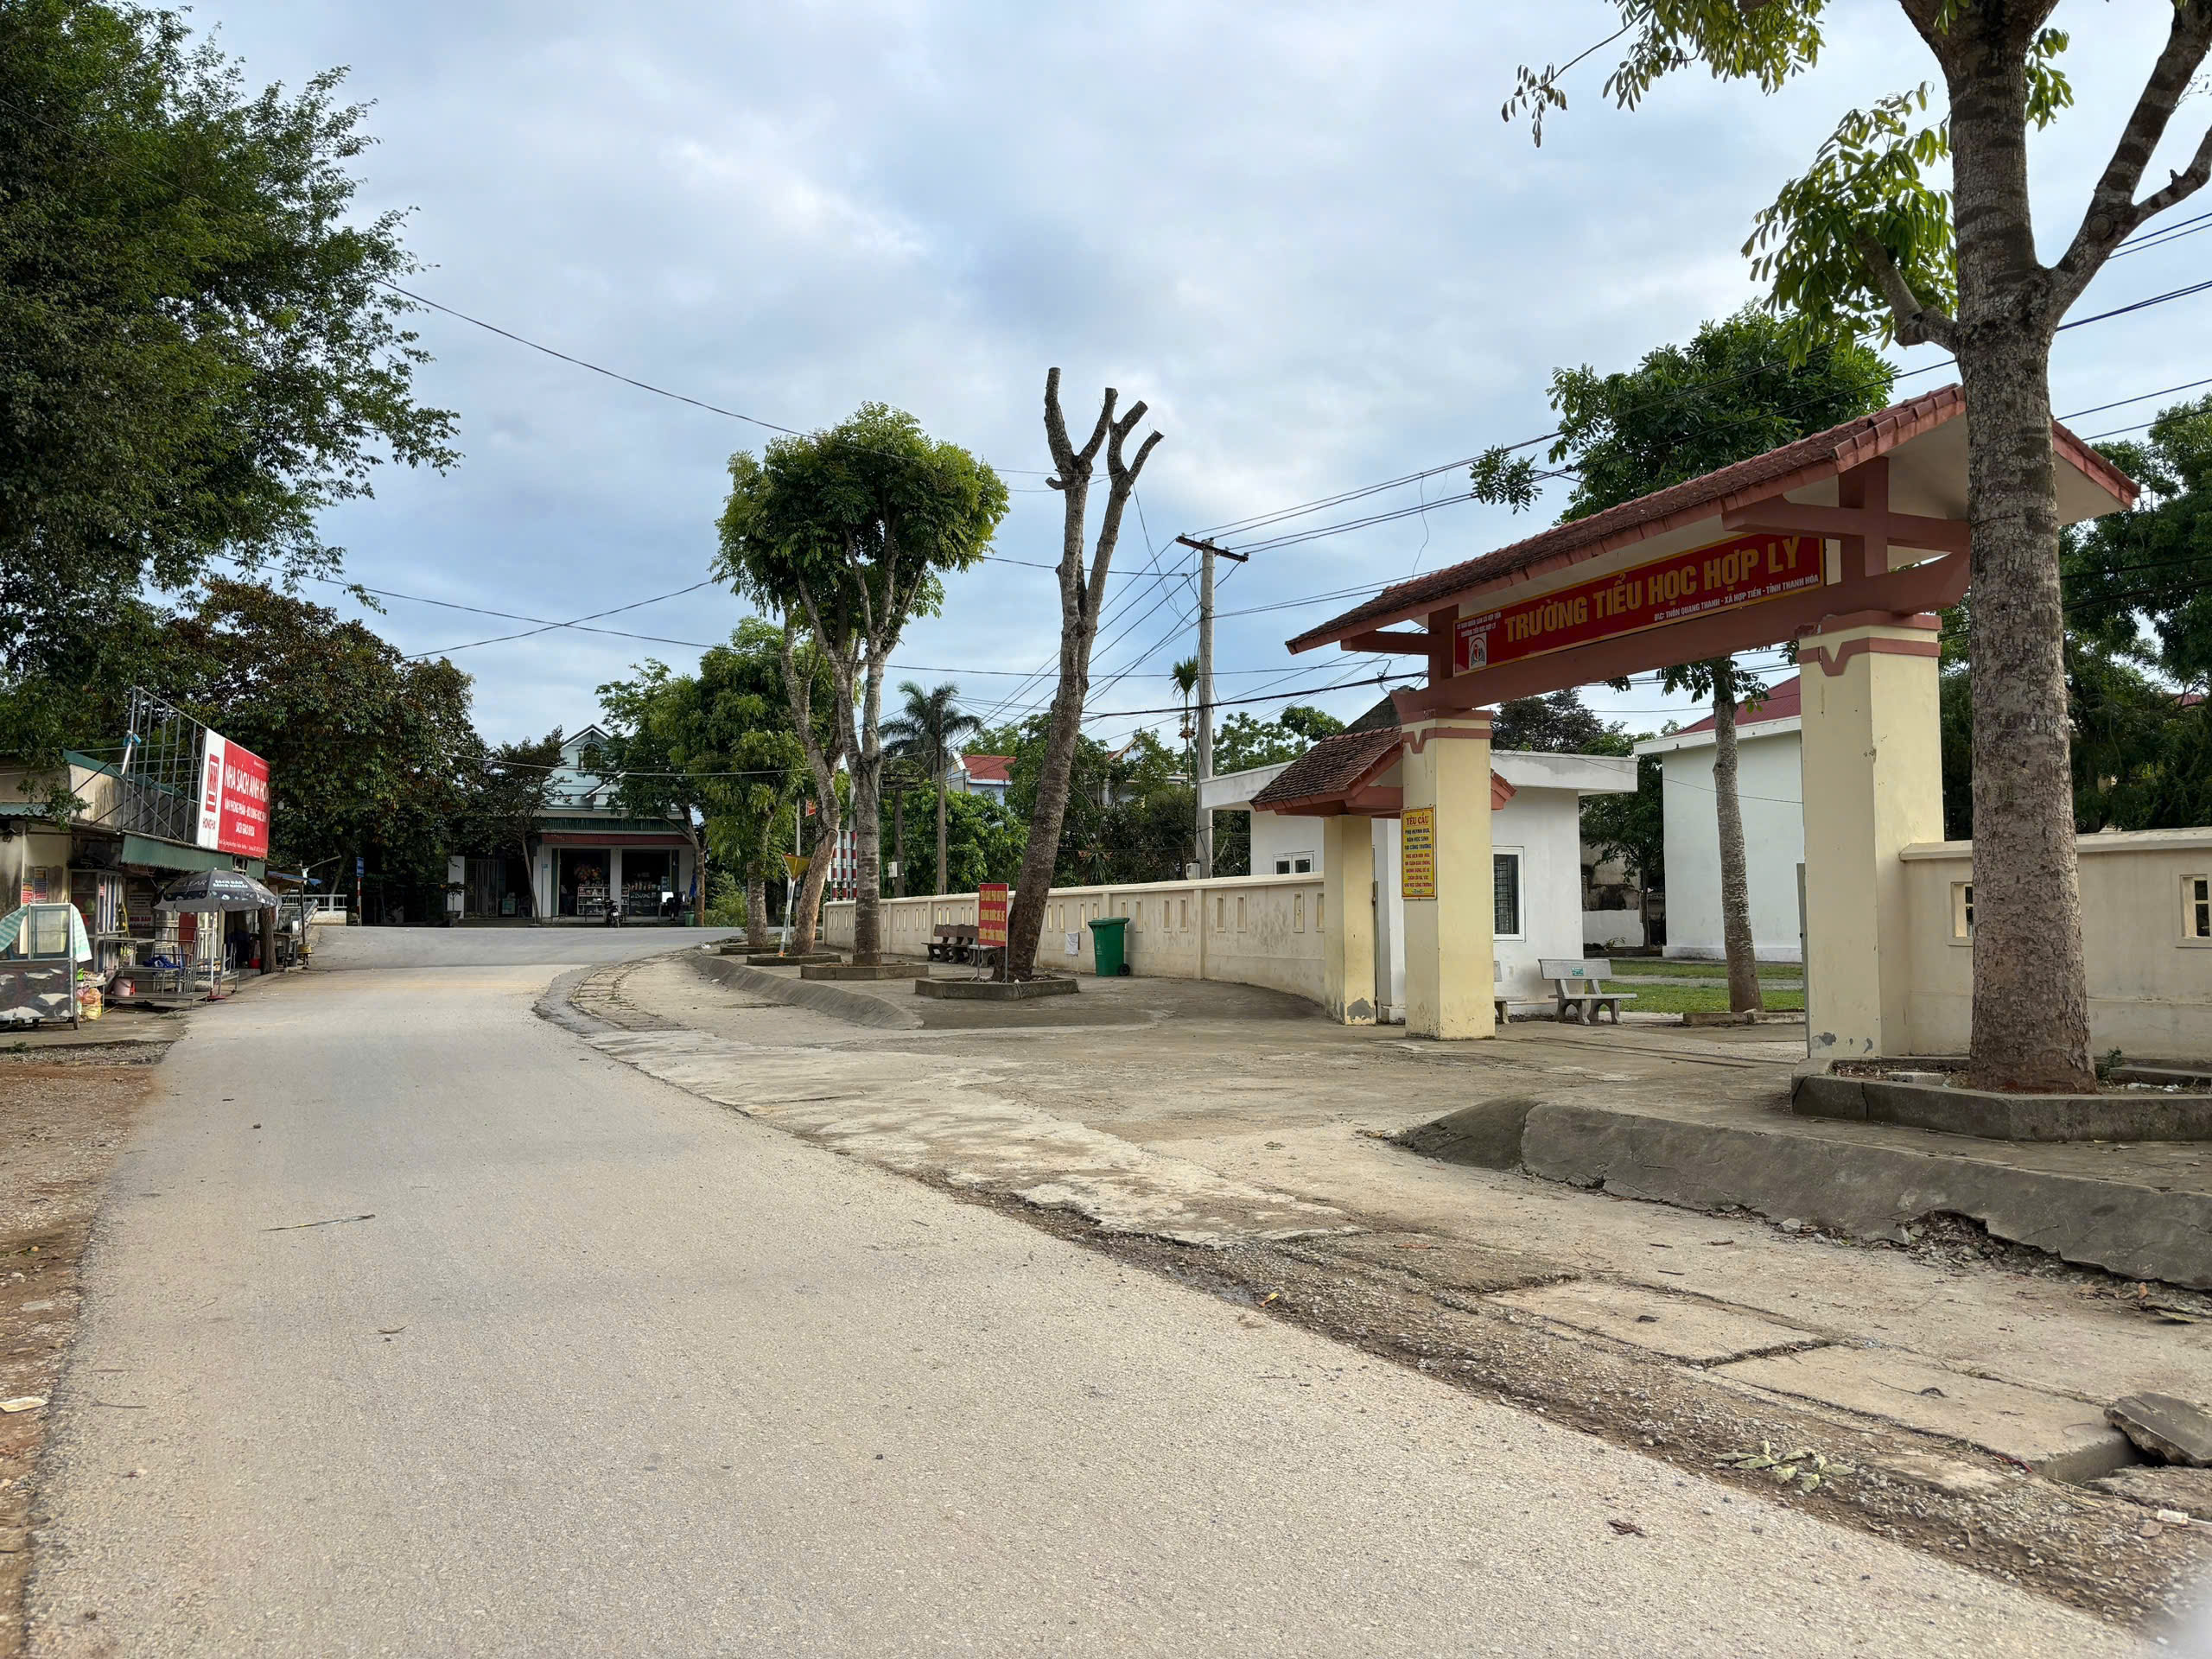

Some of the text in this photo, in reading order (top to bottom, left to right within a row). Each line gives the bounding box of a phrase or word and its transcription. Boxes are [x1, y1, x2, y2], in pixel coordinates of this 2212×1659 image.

[1504, 596, 1588, 643] TRƯỜNG
[1592, 574, 1643, 620] TIỂU
[1648, 565, 1697, 607] HỌC
[1703, 548, 1760, 592] HỢP
[1681, 603, 1700, 615] QUANG
[1782, 579, 1804, 591] THANH
[224, 760, 236, 791] NHÀ
[236, 764, 249, 796] SÁCH
[1406, 812, 1429, 826] YÊU CẦU
